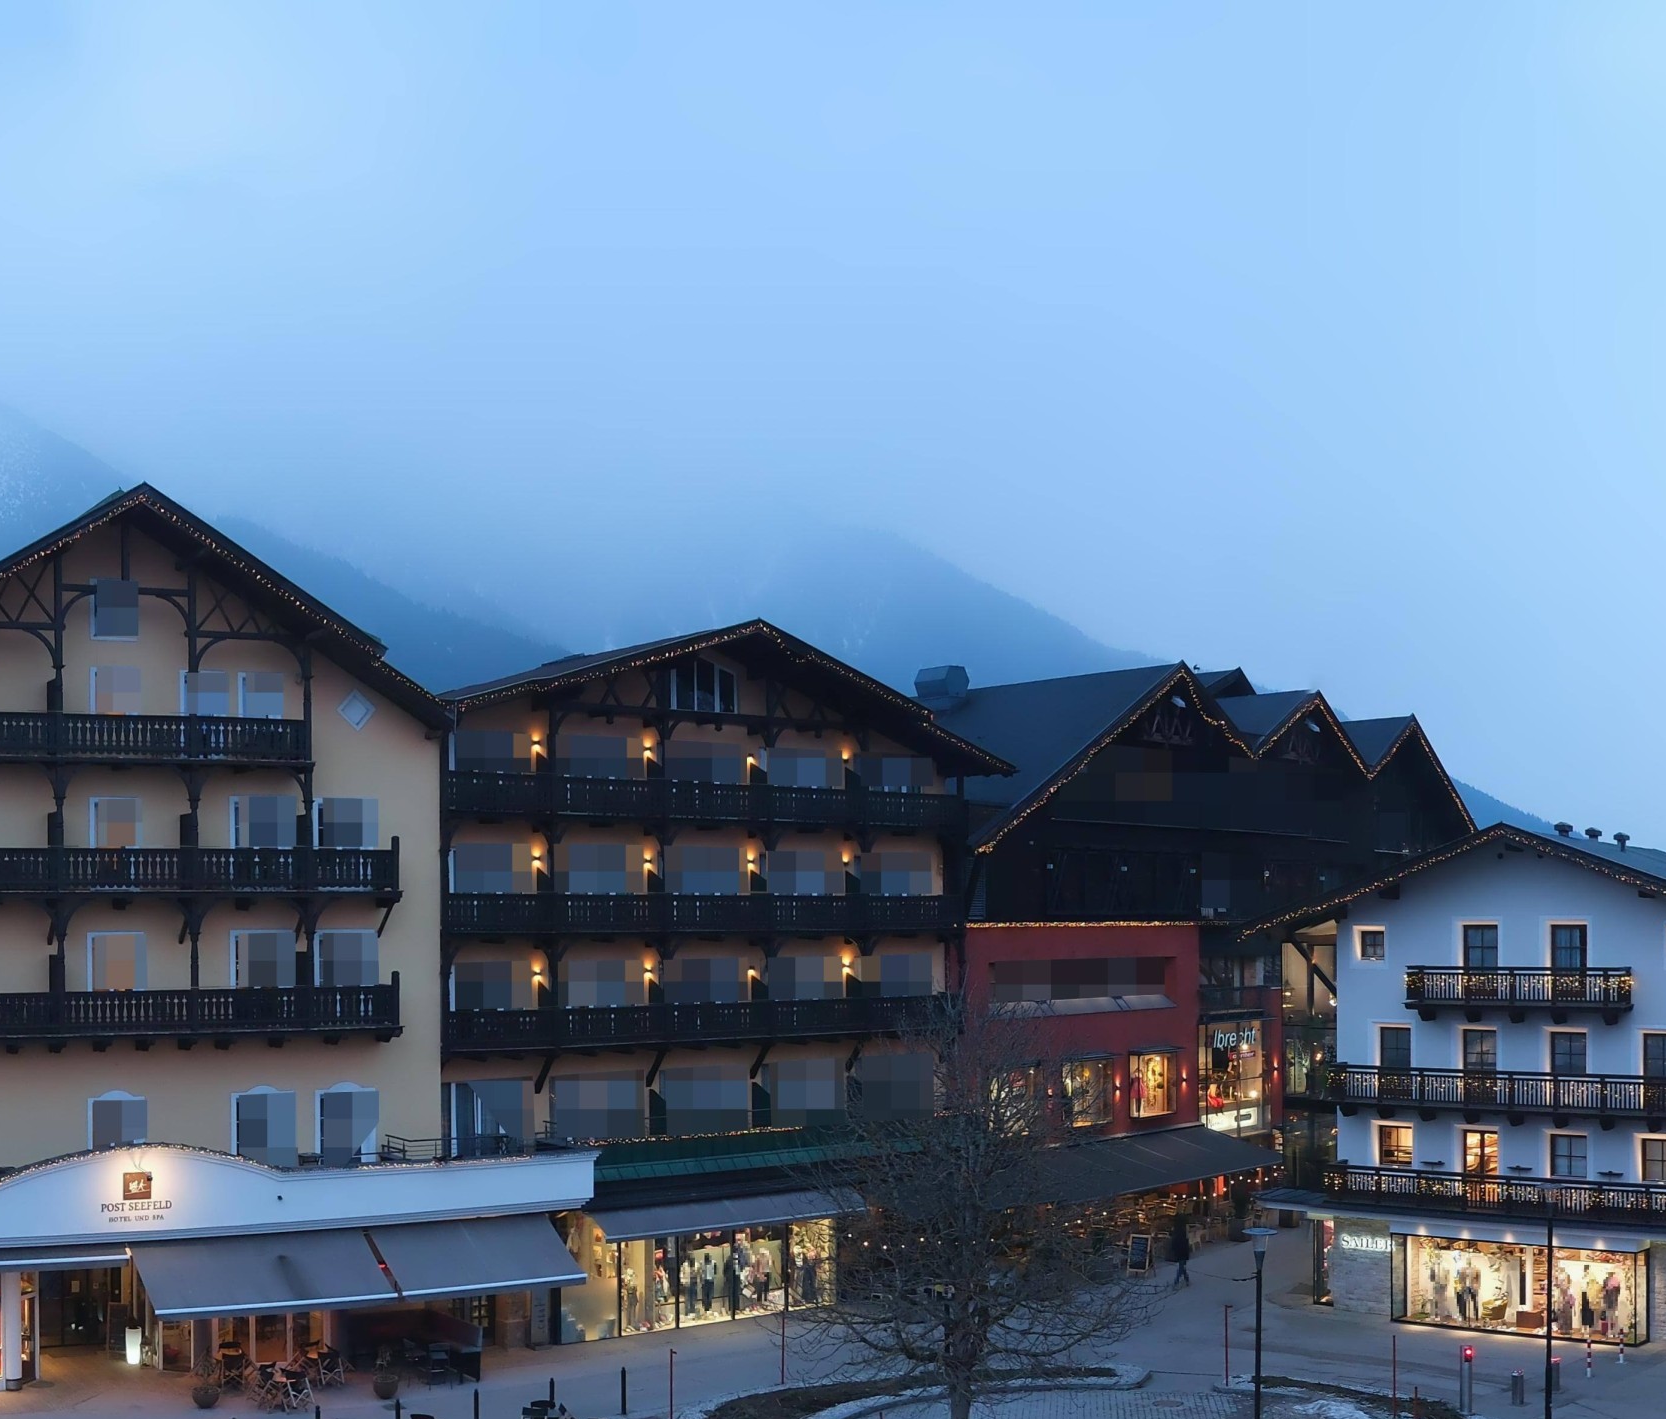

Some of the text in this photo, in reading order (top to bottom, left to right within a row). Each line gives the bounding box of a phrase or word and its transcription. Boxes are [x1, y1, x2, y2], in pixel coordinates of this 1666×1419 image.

[101, 1200, 172, 1212] POST SEEFELD
[1341, 1234, 1396, 1251] SAILER
